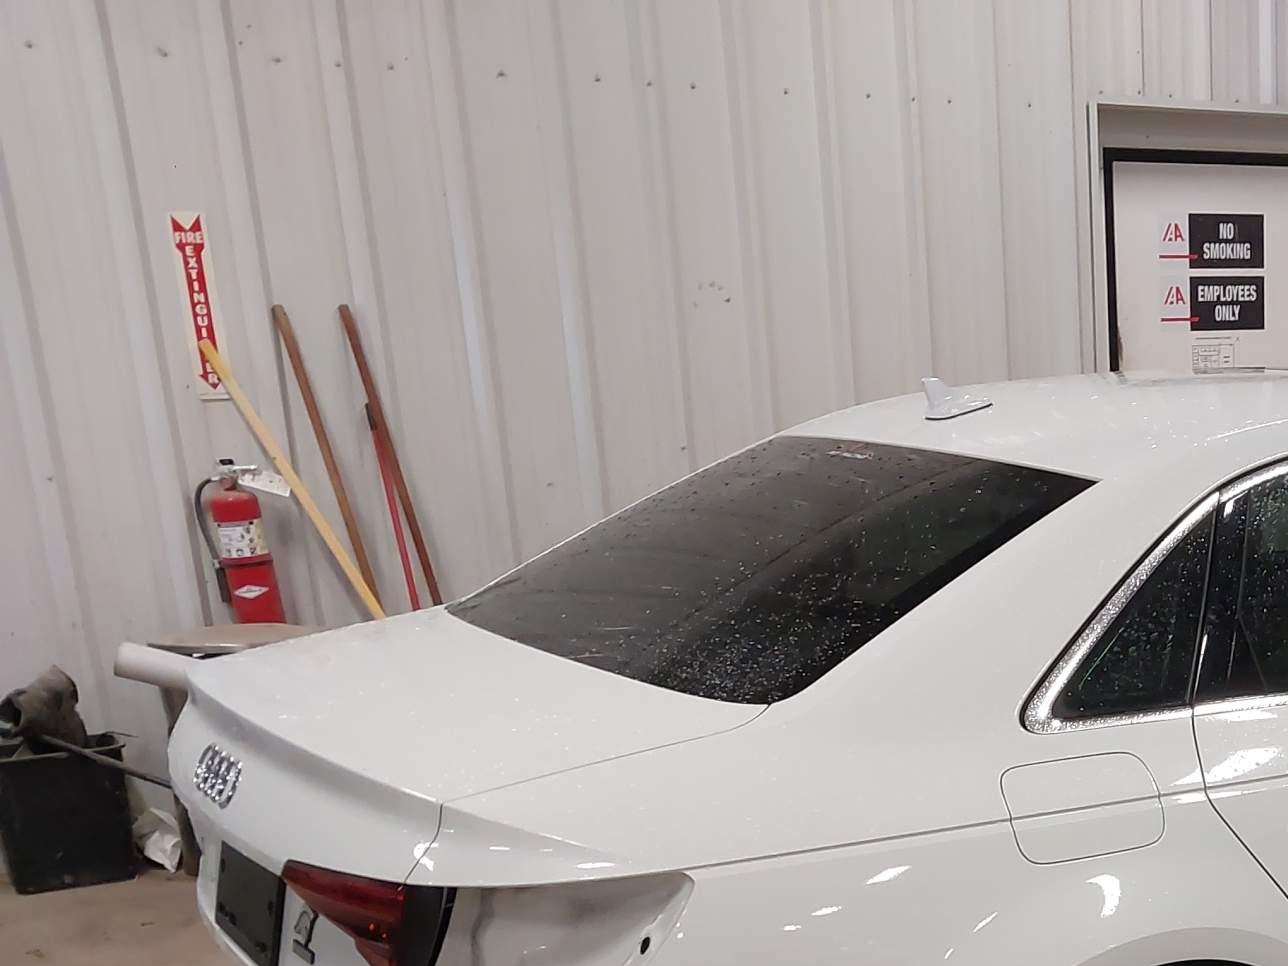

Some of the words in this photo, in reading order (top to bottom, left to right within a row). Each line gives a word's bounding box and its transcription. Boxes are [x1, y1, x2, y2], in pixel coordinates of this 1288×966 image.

[174, 231, 204, 244] FIRE
[1219, 223, 1234, 240] NO
[1203, 243, 1251, 260] SMOKING
[1197, 285, 1257, 302] EMPLOYEES
[185, 245, 219, 385] EXTINGUIR
[1215, 304, 1241, 321] ONLY
